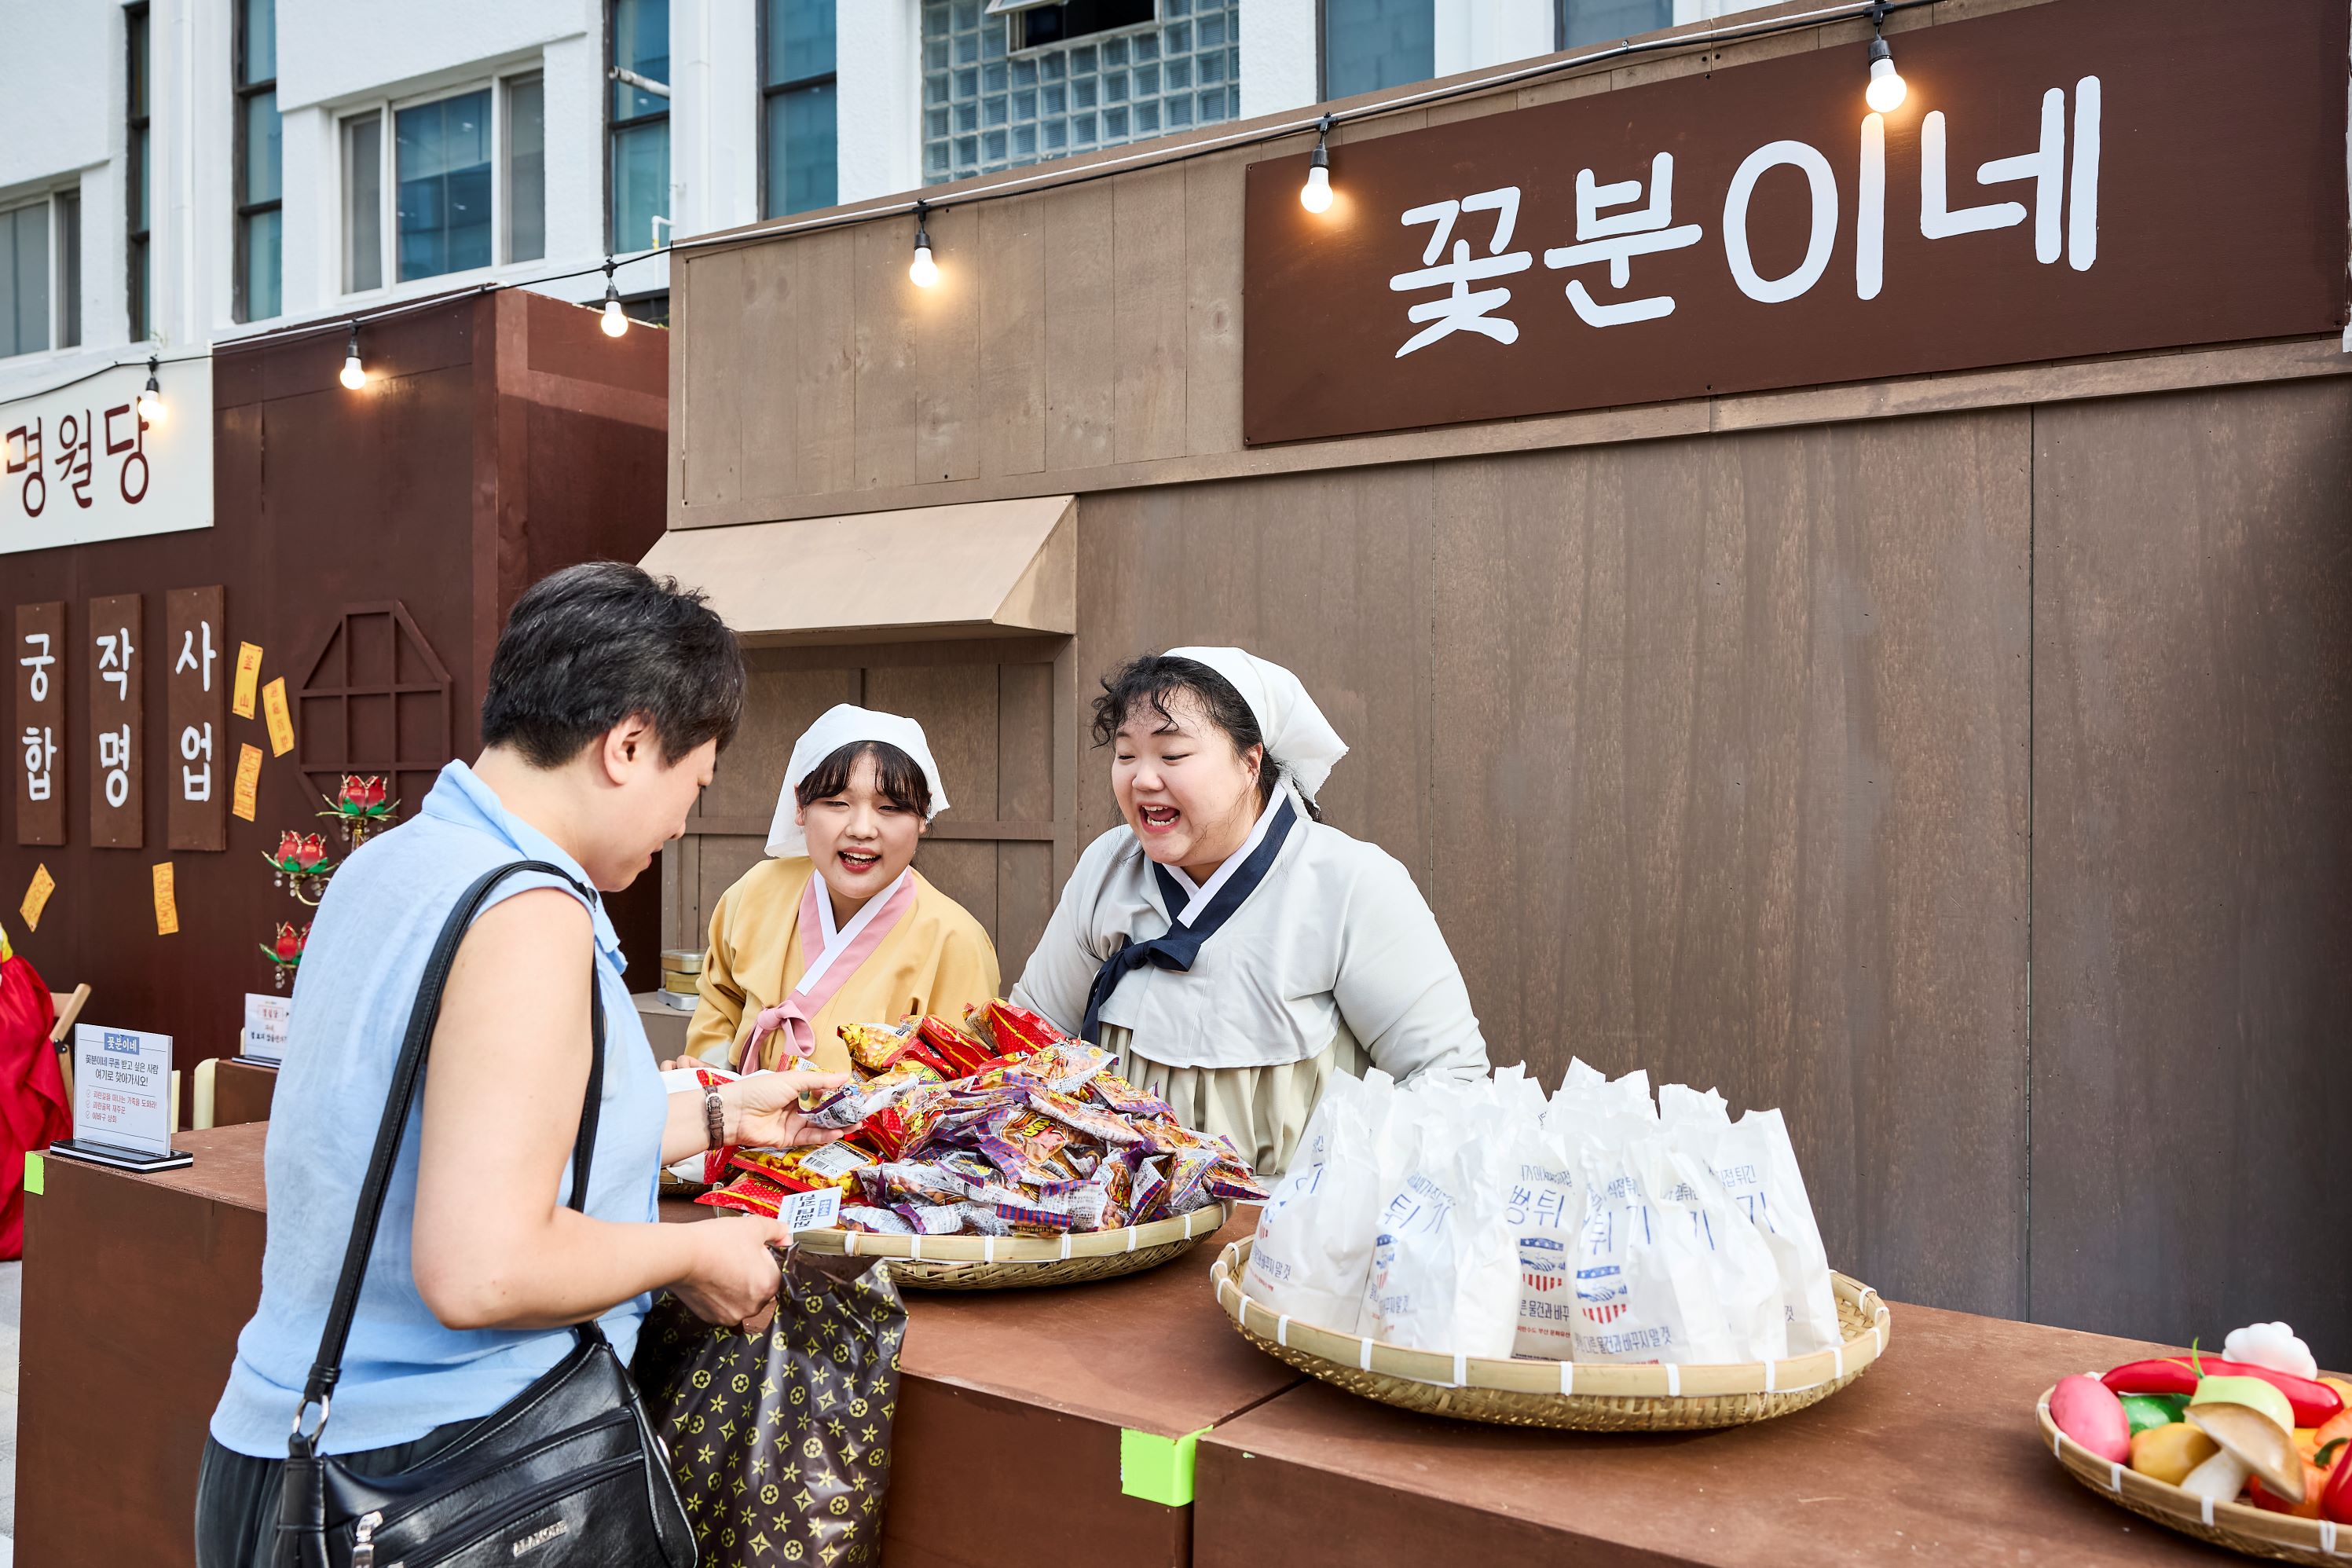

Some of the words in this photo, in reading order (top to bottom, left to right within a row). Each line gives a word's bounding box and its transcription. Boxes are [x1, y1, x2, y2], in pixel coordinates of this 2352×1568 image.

[1389, 75, 2102, 359] 꽃분이네
[6, 395, 150, 518] 명월당
[20, 633, 57, 801] 궁합
[96, 627, 134, 808] 작명
[175, 621, 217, 802] 사업
[86, 1054, 108, 1066] 꽃분이네
[108, 1057, 120, 1068] 쿠폰
[121, 1060, 133, 1070] 받고
[134, 1061, 145, 1073] 싶은
[147, 1064, 159, 1075] 사람
[95, 1068, 114, 1081] 여기로
[115, 1072, 148, 1086] 찾아가시오!
[107, 1035, 137, 1053] 꽃분이네
[1529, 1300, 1552, 1320] 물건과
[1622, 1330, 1650, 1351] 바꾸지
[1649, 1328, 1661, 1347] 말
[1660, 1325, 1672, 1345] 것
